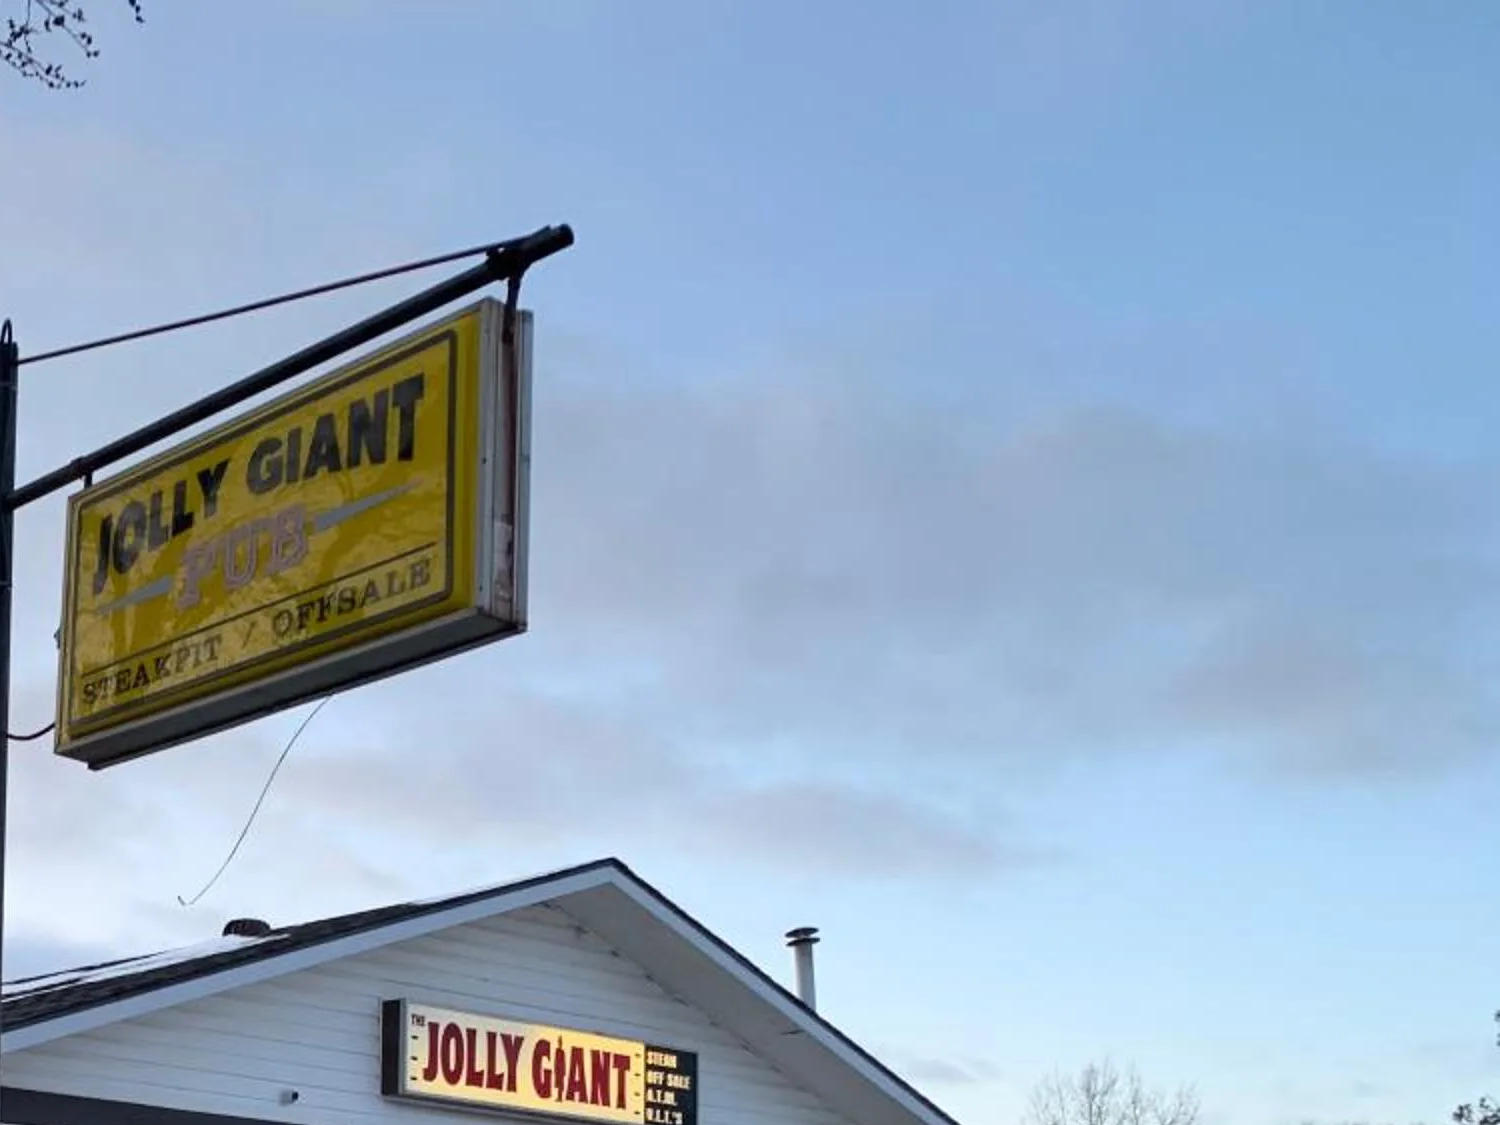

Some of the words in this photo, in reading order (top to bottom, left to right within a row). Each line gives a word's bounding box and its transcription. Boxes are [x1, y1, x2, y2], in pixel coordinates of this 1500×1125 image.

[92, 458, 231, 598] JOLLY
[244, 373, 426, 496] GIANT
[177, 501, 309, 611] PUB
[270, 556, 433, 640] OFFSALE
[411, 1013, 426, 1027] THE
[422, 1022, 525, 1092] JOLLY
[531, 1035, 631, 1110] GIANT
